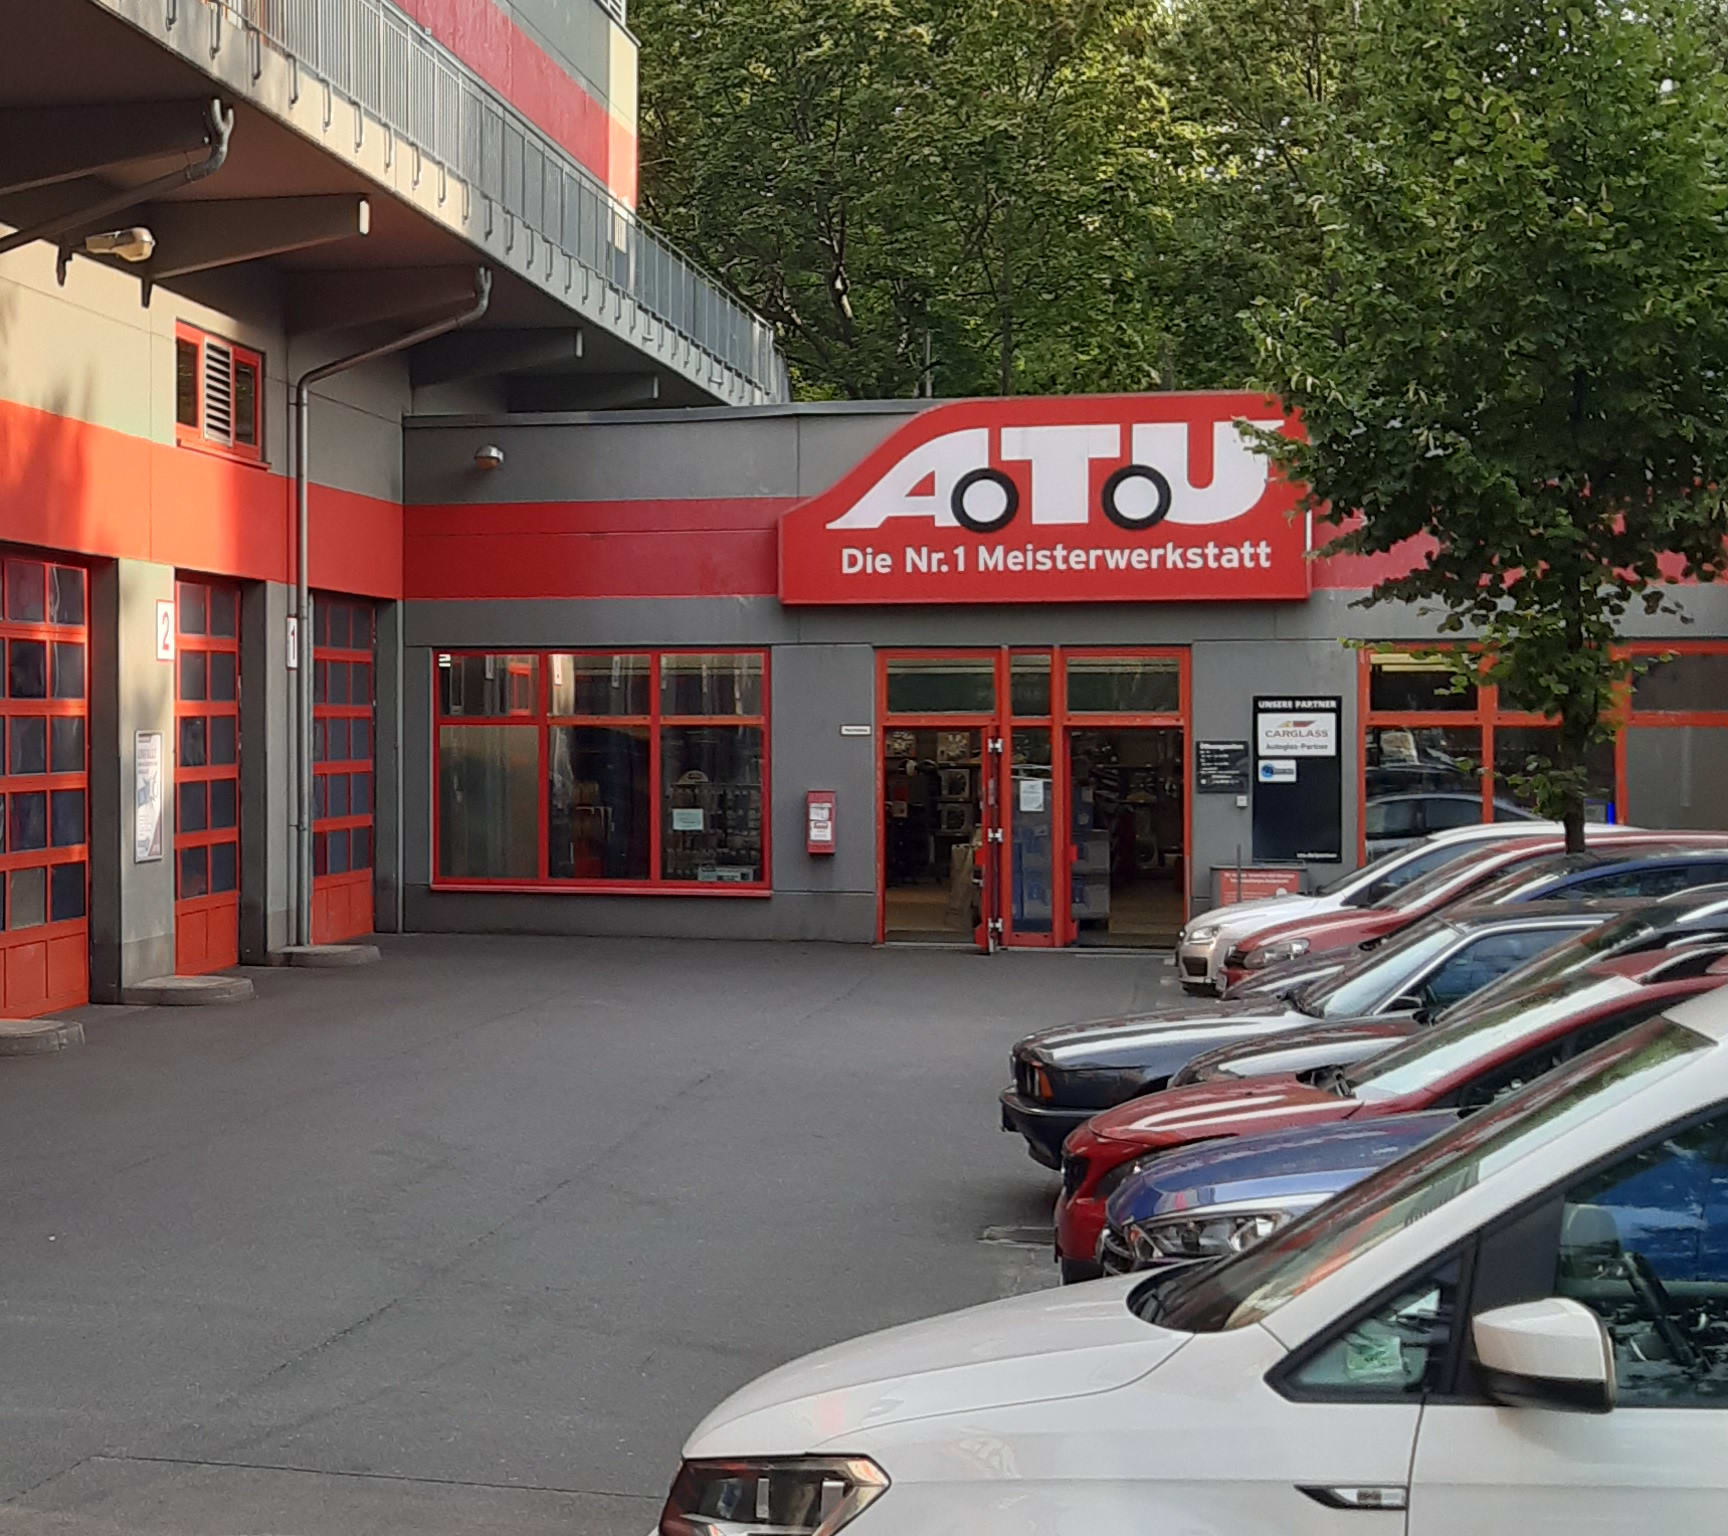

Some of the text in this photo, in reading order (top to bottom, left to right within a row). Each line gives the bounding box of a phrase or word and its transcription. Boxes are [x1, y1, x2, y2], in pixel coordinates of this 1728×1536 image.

[825, 420, 1285, 533] ATU
[841, 546, 892, 575] Die
[977, 540, 1272, 572] Meisterwerkstatt
[161, 610, 170, 652] 2
[1258, 700, 1337, 710] UNSERE PARTNER
[1264, 729, 1329, 738] CARGLASS
